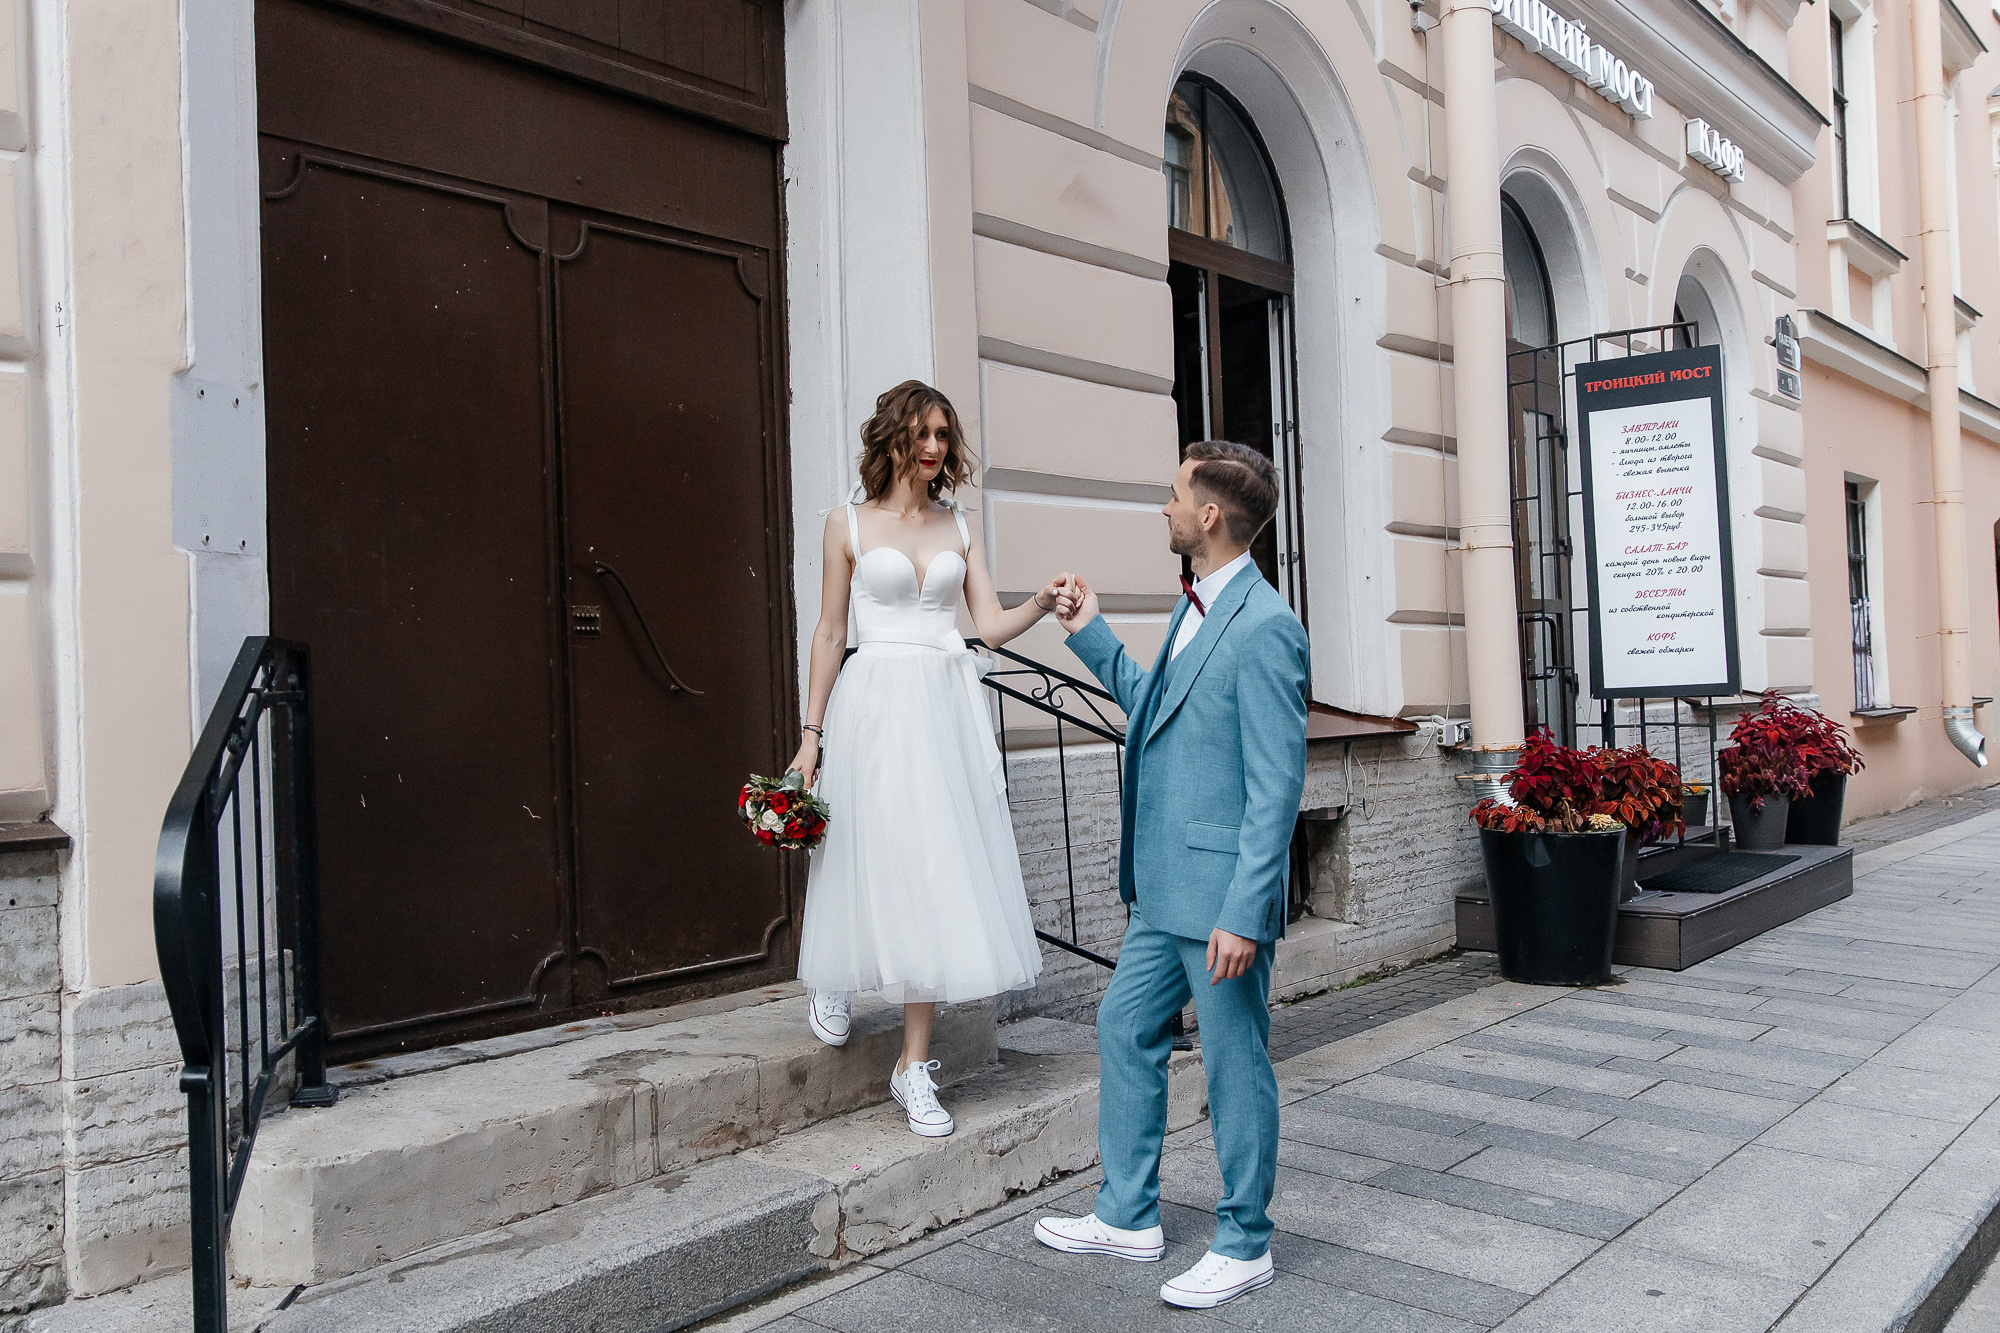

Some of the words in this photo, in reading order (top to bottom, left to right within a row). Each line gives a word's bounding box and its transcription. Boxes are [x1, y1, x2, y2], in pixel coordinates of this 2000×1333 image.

[1592, 44, 1654, 119] МОСТ
[1693, 118, 1745, 182] КАФЕ
[1584, 371, 1665, 392] ТРОИЦКИЙ
[1670, 366, 1712, 382] МОСТ
[1621, 420, 1680, 434] ЗАВТРАКИ
[1625, 433, 1677, 445] 8.00-12.00
[1619, 457, 1644, 466] блюда
[1660, 453, 1693, 464] творога
[1623, 469, 1653, 477] свежая
[1656, 465, 1690, 474] выпечка
[1615, 486, 1693, 500] БИЗНЕС-ЛАНЧИ
[1626, 499, 1683, 511] 12.00-16.00
[1625, 512, 1658, 522] большой
[1661, 511, 1685, 520] выбор
[1629, 522, 1683, 533] 245-345руб.
[1624, 542, 1689, 555] САЛАТ-БАР
[1605, 558, 1638, 568] каждый
[1641, 558, 1659, 567] день
[1662, 556, 1687, 564] новые
[1690, 554, 1711, 563] виды
[1613, 570, 1641, 579] скидка
[1645, 567, 1664, 576] 20%
[1676, 565, 1703, 574] 20.00
[1634, 588, 1687, 599] ДЕСЕРТЫ
[1620, 602, 1671, 613] собственной
[1656, 608, 1714, 620] кондитерской
[1647, 632, 1677, 642] КОФЕ
[1627, 647, 1655, 656] свежей
[1658, 646, 1695, 654] обжарки
